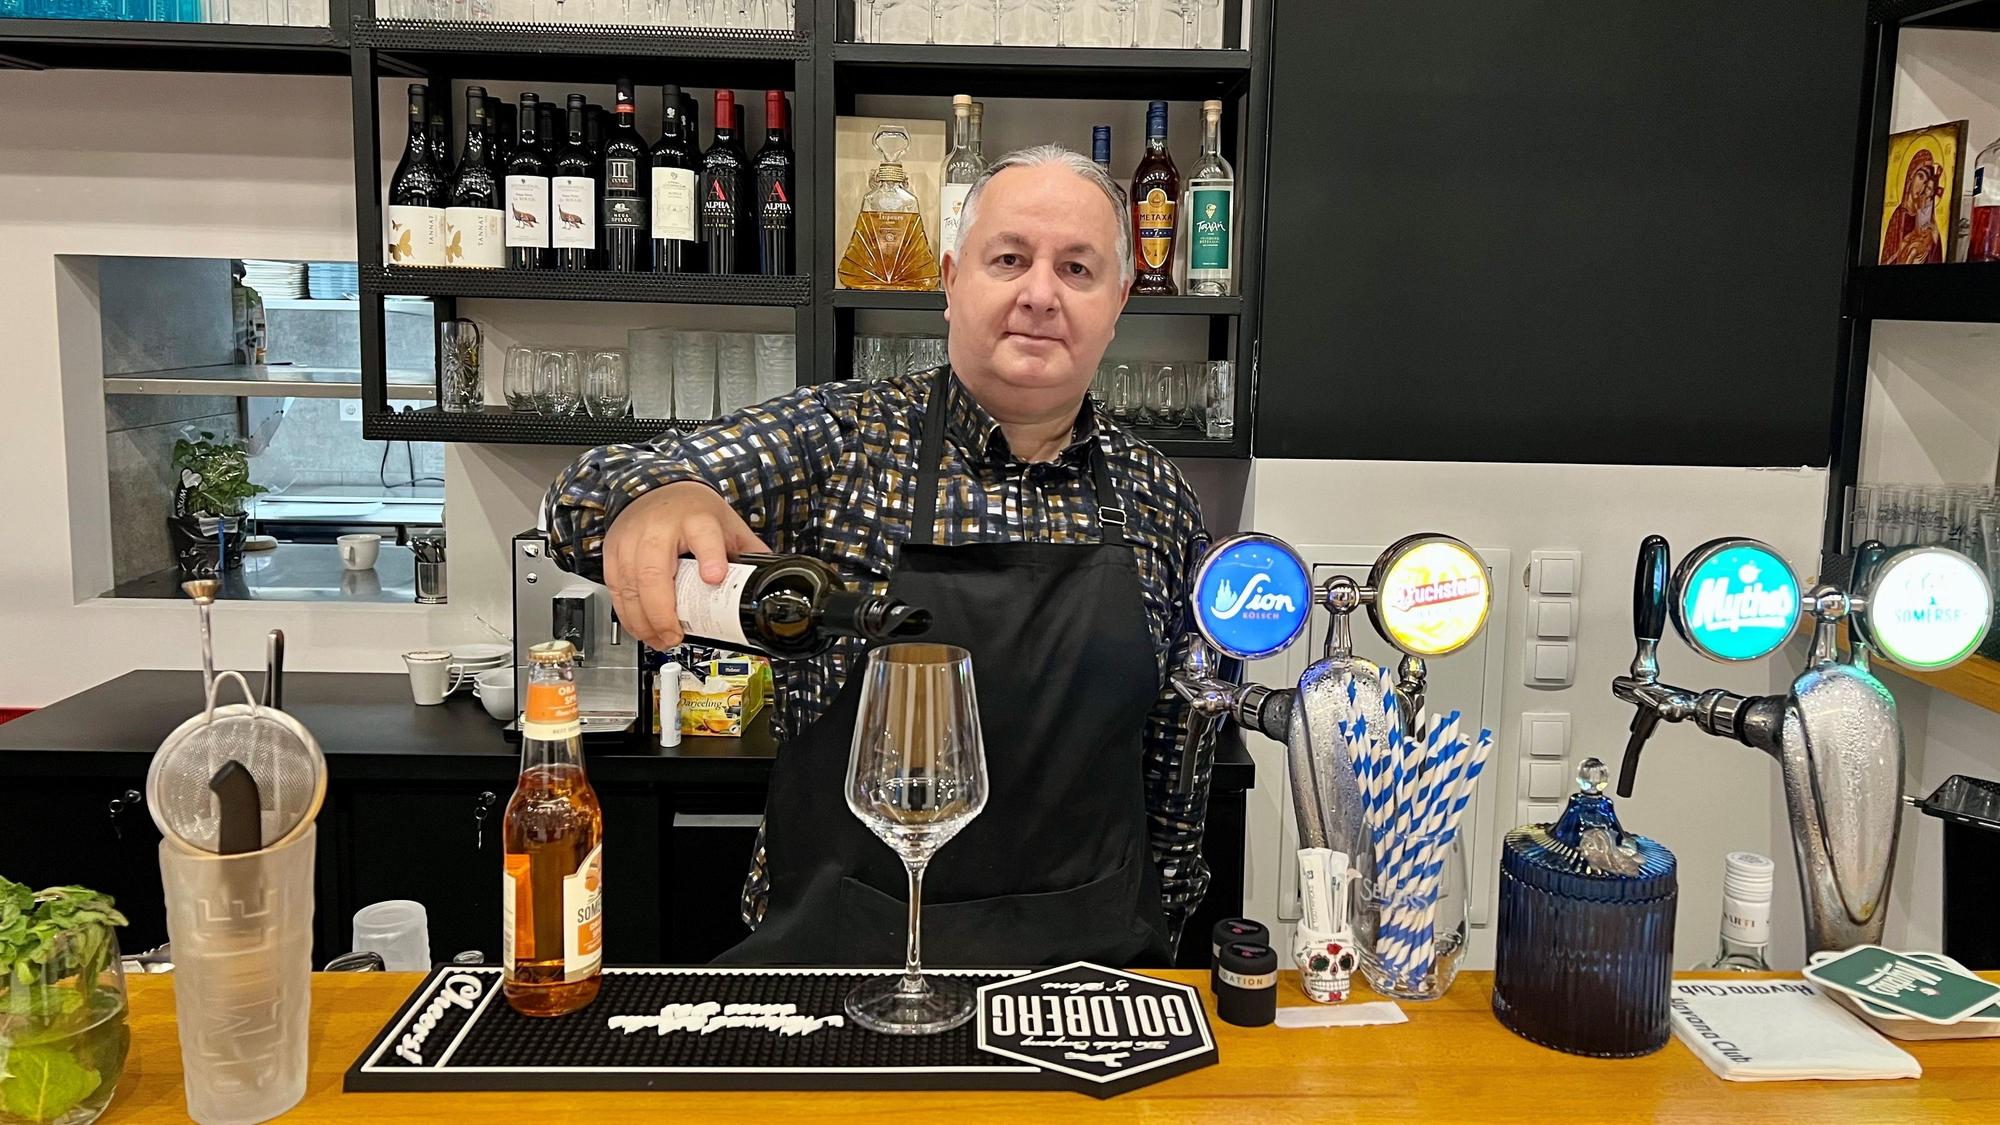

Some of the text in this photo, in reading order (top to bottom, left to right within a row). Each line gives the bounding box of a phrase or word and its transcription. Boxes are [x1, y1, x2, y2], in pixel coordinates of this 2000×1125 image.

[704, 201, 730, 209] ALPHA
[764, 202, 791, 211] ALPHA
[1139, 213, 1173, 221] METAXA
[1210, 573, 1296, 620] Sion
[1692, 576, 1795, 631] Mythos
[1040, 981, 1105, 994] Sons
[1677, 984, 1816, 996] Havana Club
[991, 994, 1194, 1037] GOLDBERG
[1711, 1040, 1753, 1064] Club
